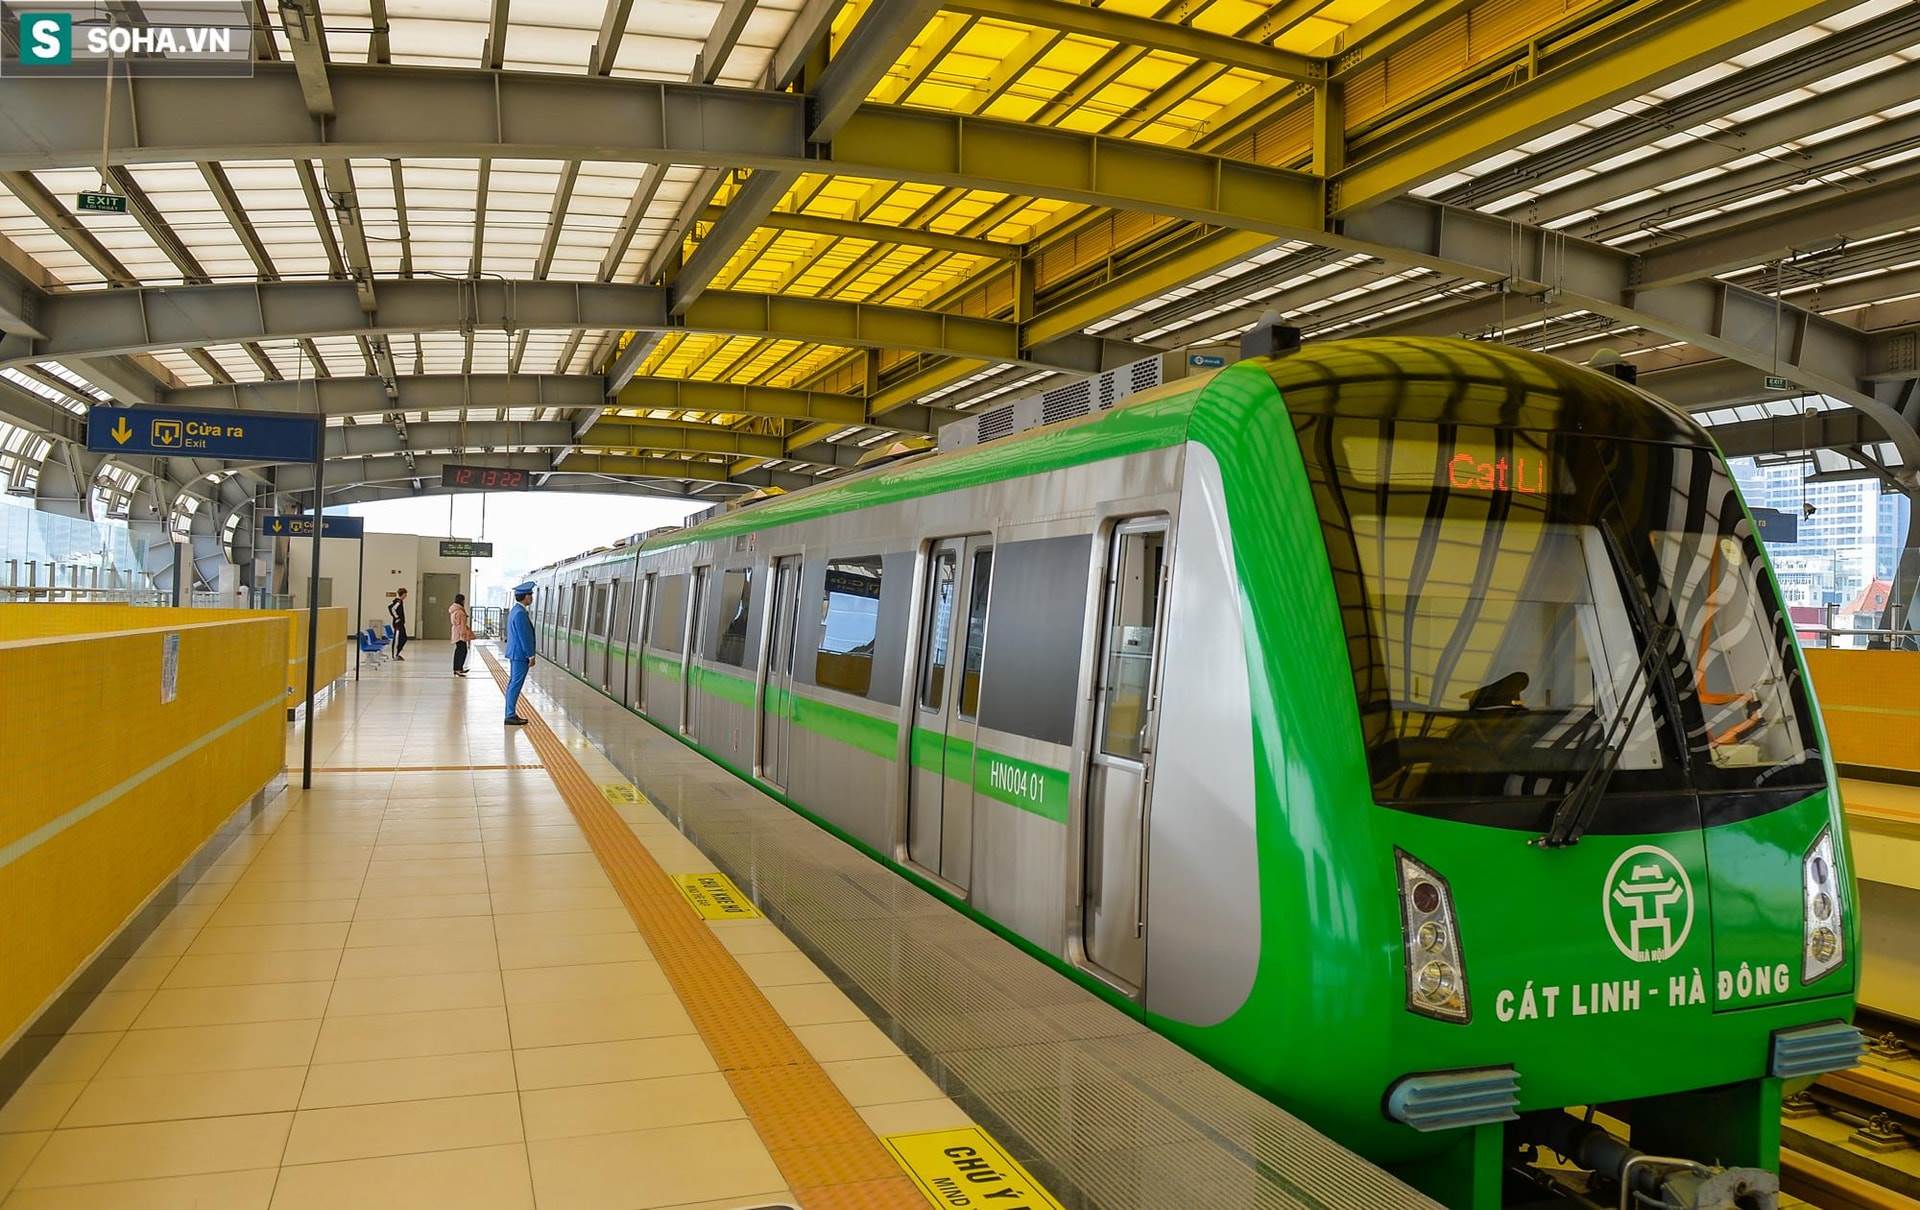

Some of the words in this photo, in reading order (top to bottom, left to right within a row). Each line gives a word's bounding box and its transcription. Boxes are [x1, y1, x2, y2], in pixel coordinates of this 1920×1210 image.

[87, 196, 118, 206] EXIT
[185, 438, 206, 448] Exit
[186, 421, 221, 436] Cửa
[226, 426, 243, 438] ra
[1448, 454, 1508, 491] Cat
[991, 760, 1027, 798] HN004
[1030, 773, 1044, 804] 01
[1495, 980, 1560, 1022] CÁT
[1572, 980, 1640, 1016] LINH
[1669, 967, 1706, 1007] HÀ
[1717, 961, 1789, 1001] ĐÔNG
[944, 1146, 1006, 1183] CHÚ
[983, 1187, 1025, 1199] Ý
[931, 1177, 971, 1206] MIND
